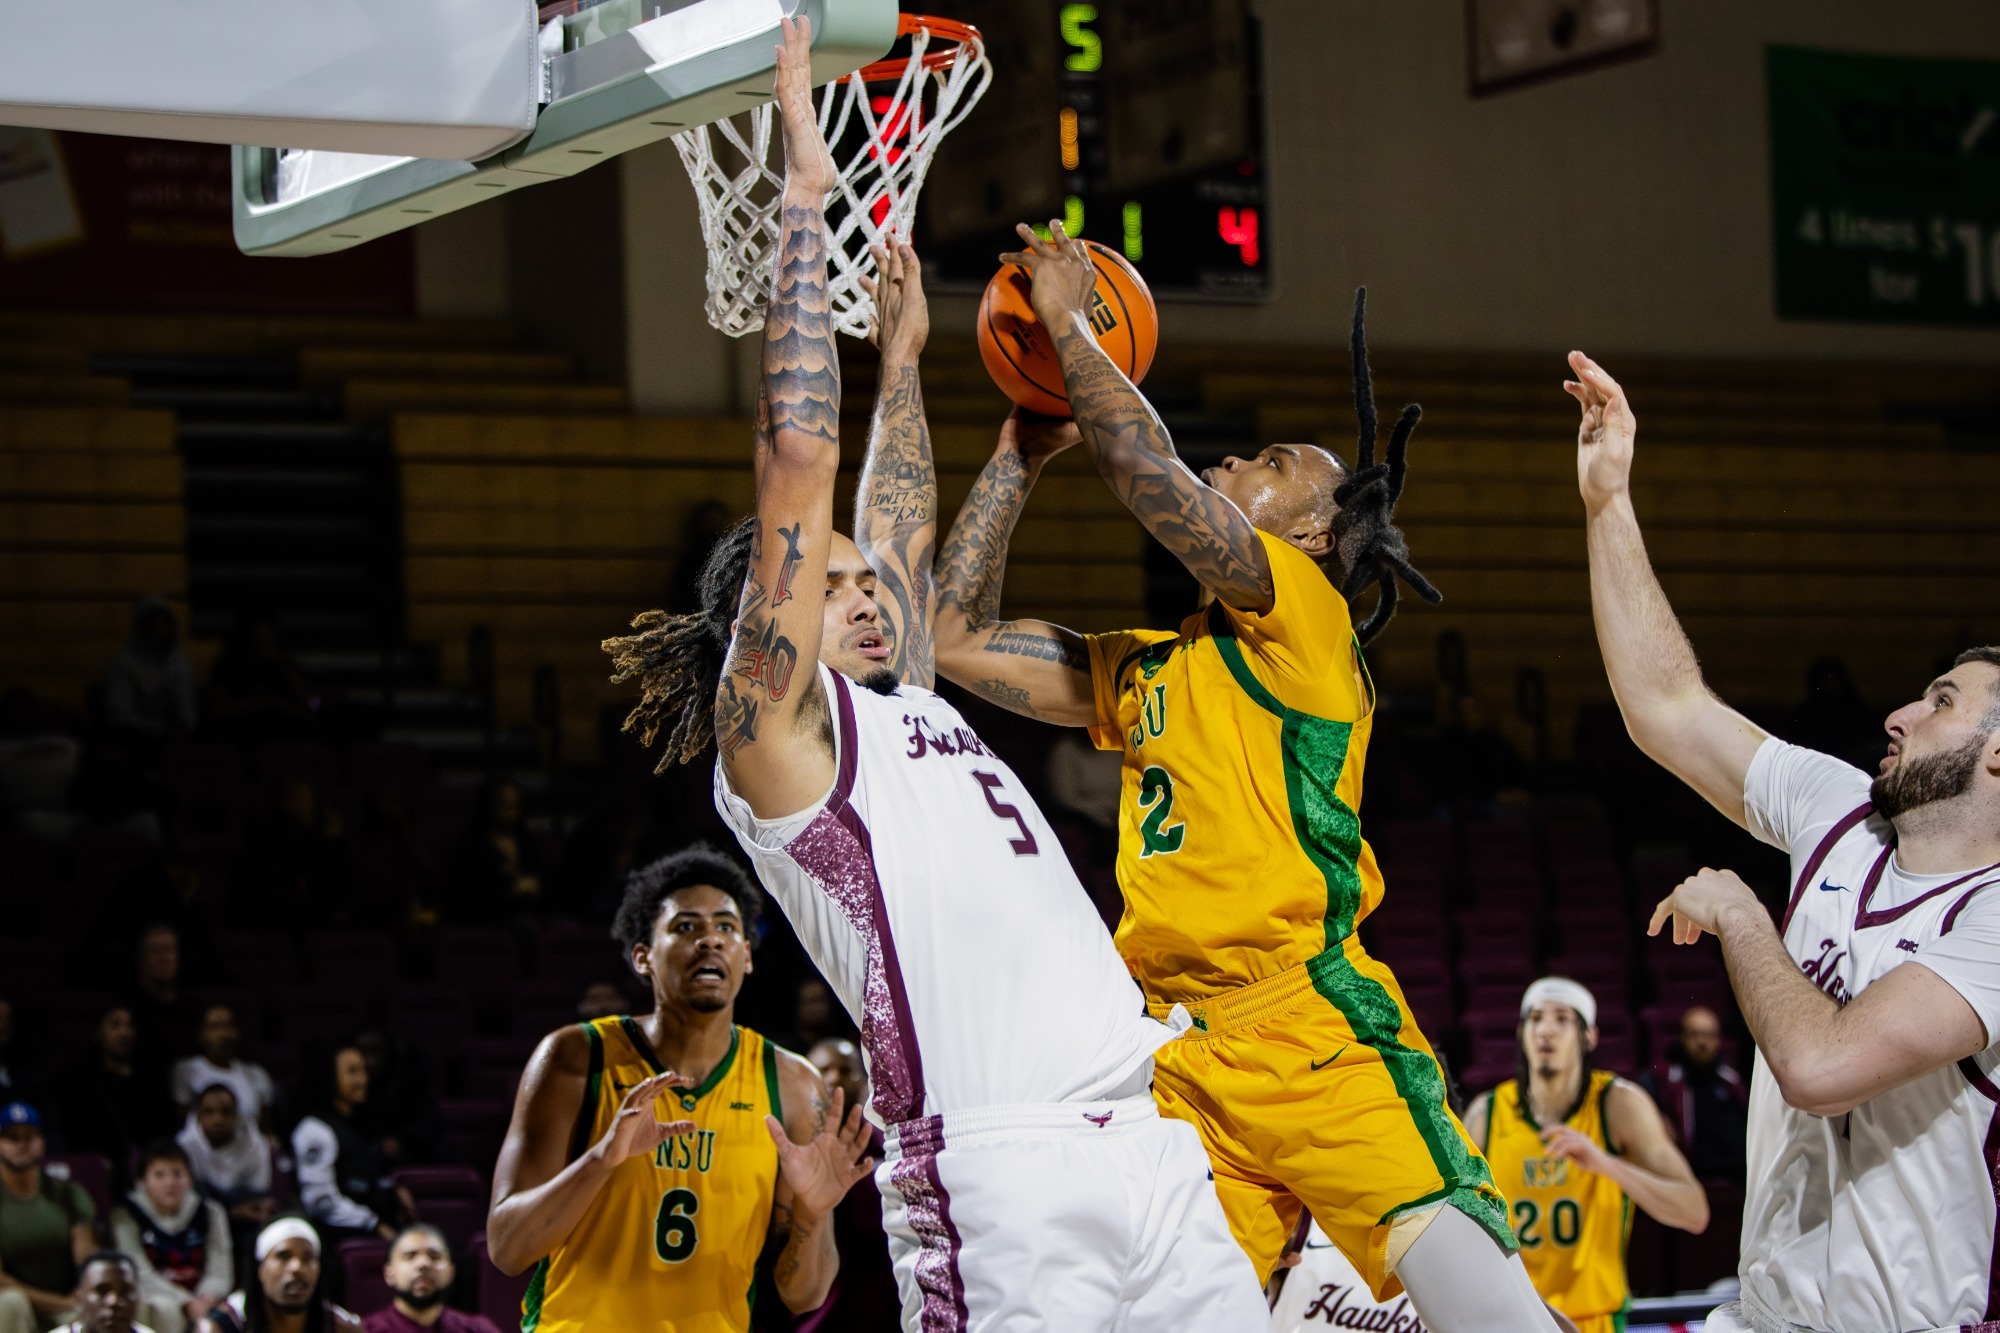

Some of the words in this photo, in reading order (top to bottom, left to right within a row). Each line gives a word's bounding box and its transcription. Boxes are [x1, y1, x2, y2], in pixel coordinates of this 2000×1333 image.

[1060, 4, 1102, 72] 5
[1218, 206, 1259, 266] 4
[1830, 207, 1919, 250] lines
[895, 504, 927, 523] SKY
[970, 768, 1040, 857] 5
[1138, 765, 1185, 859] 2
[656, 1130, 715, 1174] NSU
[654, 1187, 700, 1264] 6
[1513, 1198, 1583, 1250] 20
